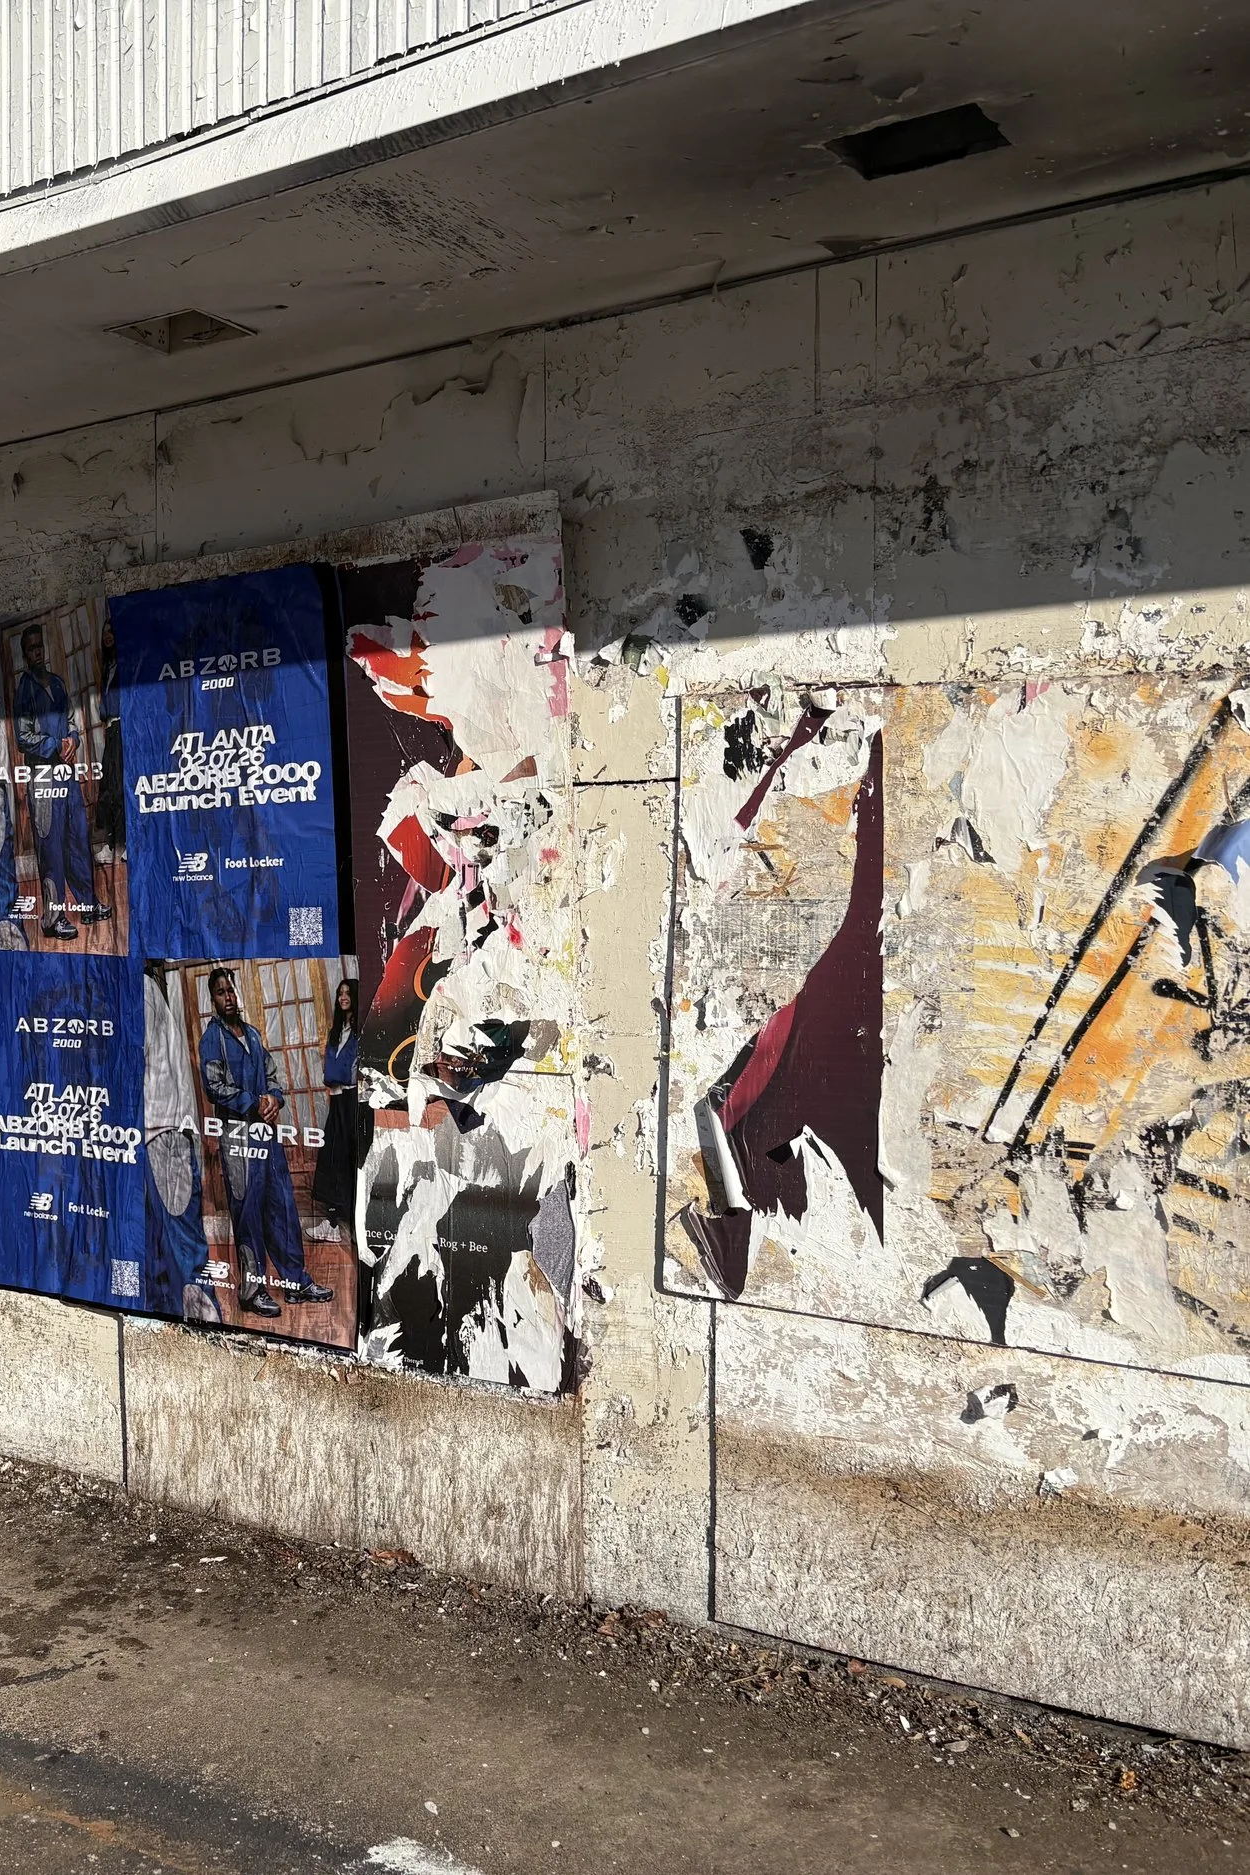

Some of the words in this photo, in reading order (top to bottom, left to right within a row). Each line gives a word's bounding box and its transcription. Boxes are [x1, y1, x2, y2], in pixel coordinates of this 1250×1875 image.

[158, 647, 282, 681] ABZORB
[201, 677, 235, 691] 2000
[170, 724, 276, 755] ATLANTA
[134, 767, 242, 795] ABZORB
[247, 761, 321, 787] 2000
[34, 787, 69, 799] 2000
[138, 790, 232, 814] Launch
[238, 783, 317, 806] Event
[225, 858, 247, 869] Foot
[250, 856, 285, 868] Locker
[49, 902, 66, 911] Foot
[68, 902, 94, 912] Locker
[15, 1017, 114, 1037] ABZORB
[53, 1038, 82, 1049] 2000
[23, 1082, 110, 1107] ATLANTA
[89, 1123, 142, 1147] 2000
[177, 1114, 326, 1148] ABZORB
[82, 1138, 137, 1164] Event
[229, 1145, 269, 1160] 2000
[469, 1241, 488, 1253] Bee
[246, 1272, 267, 1285] Foot
[269, 1274, 302, 1291] Locker
